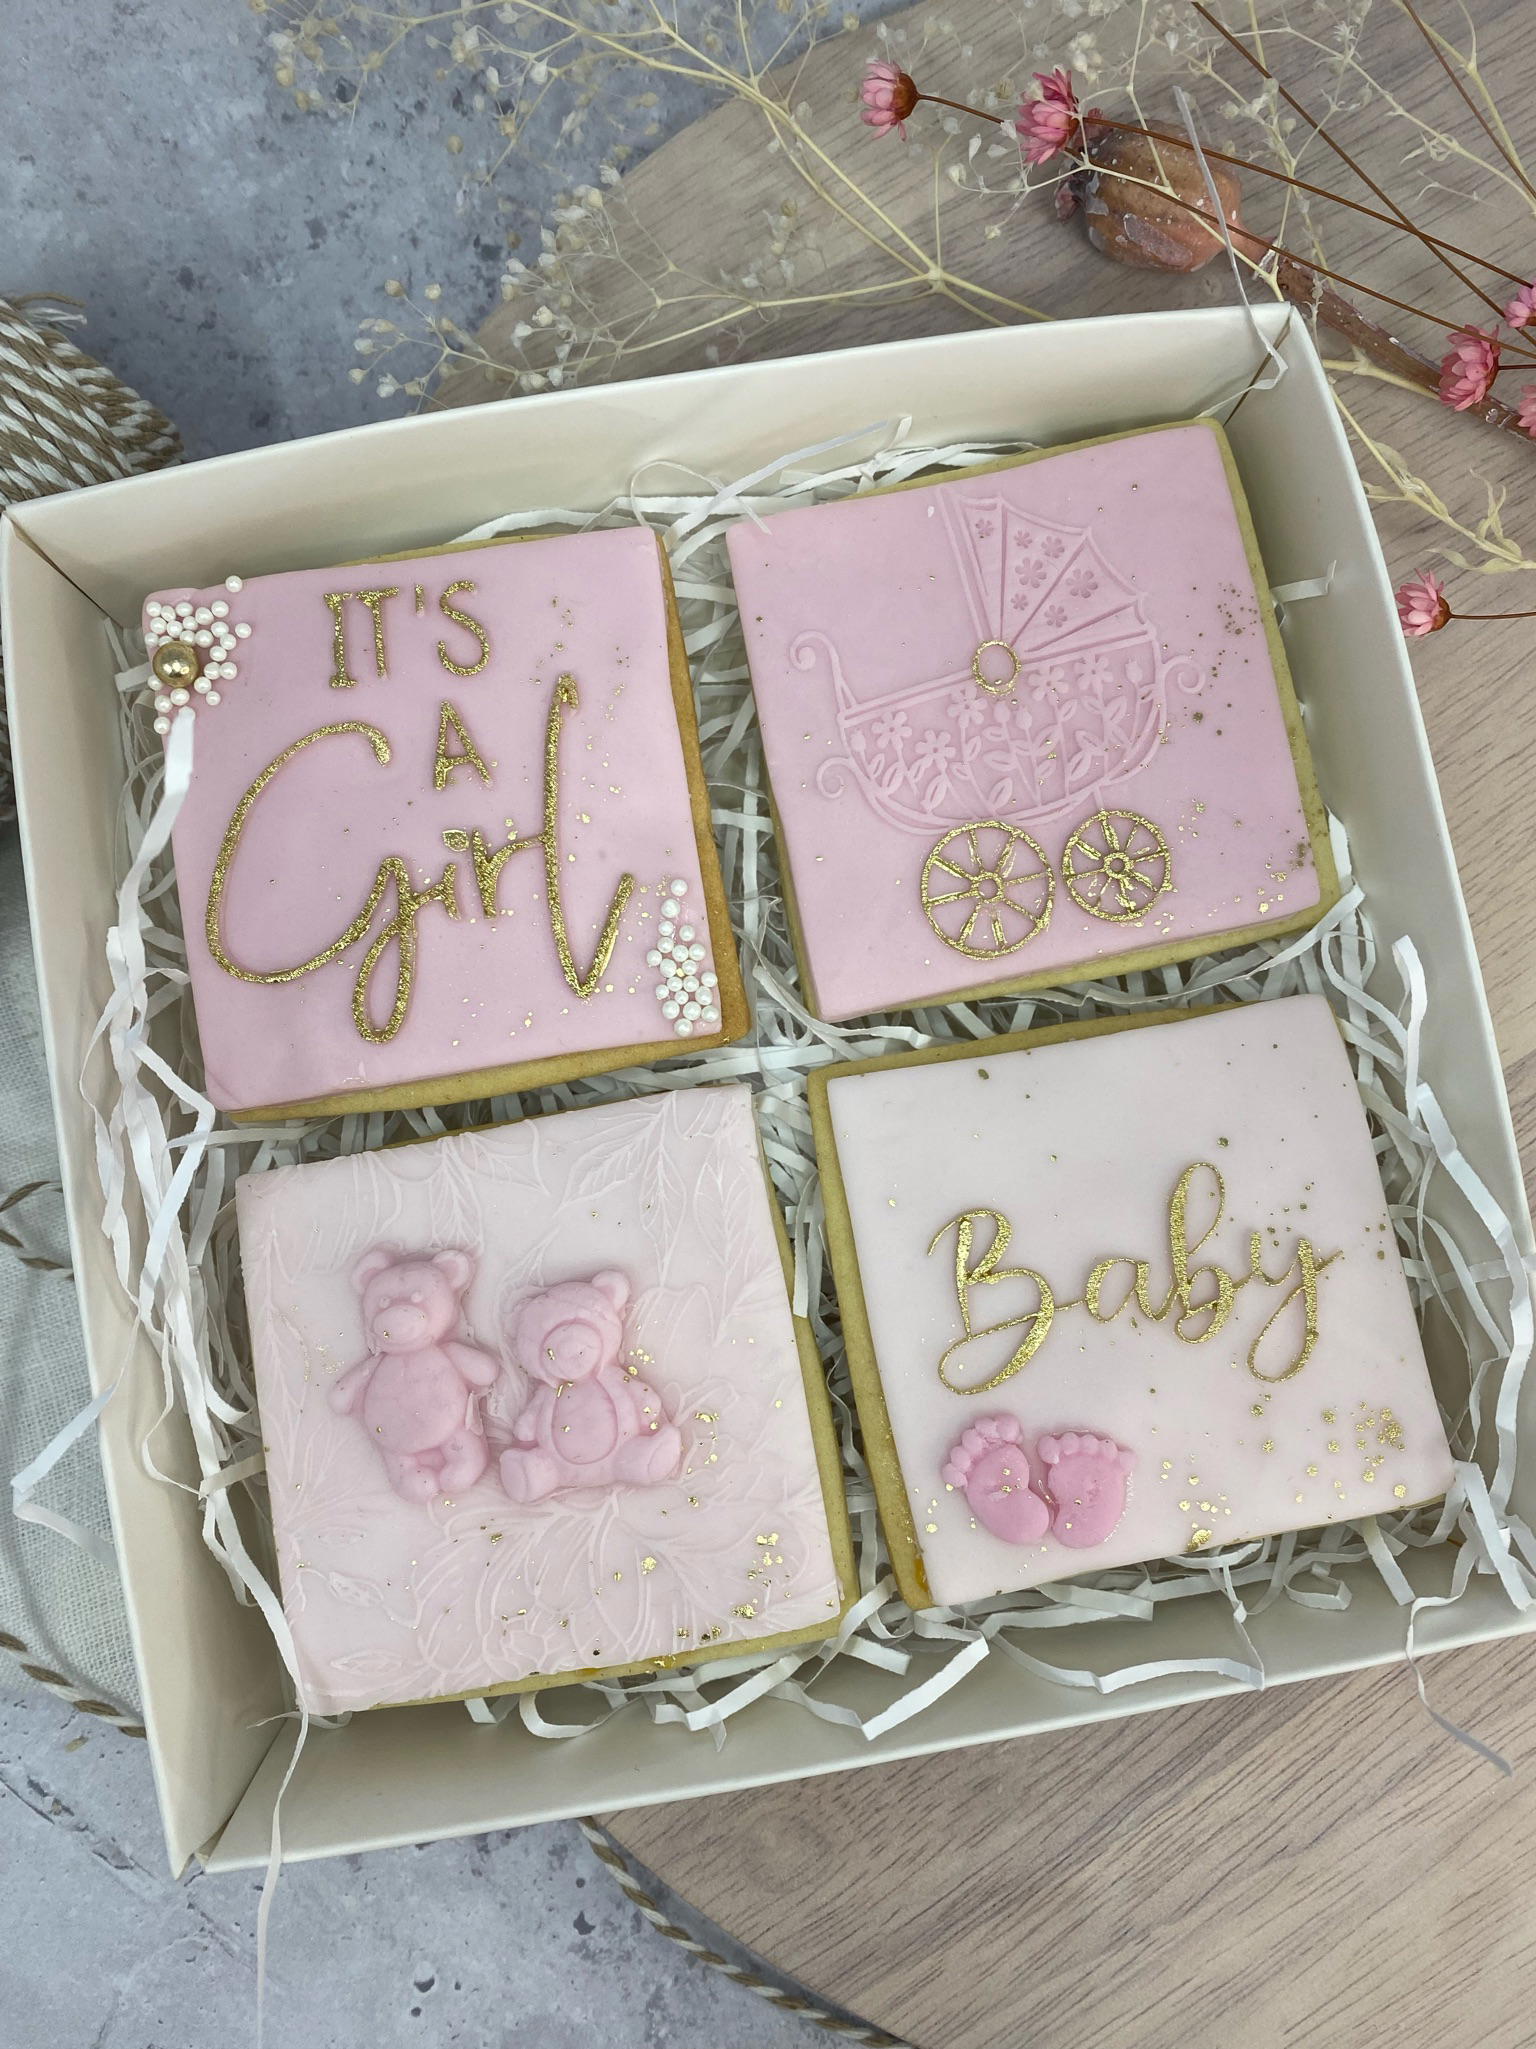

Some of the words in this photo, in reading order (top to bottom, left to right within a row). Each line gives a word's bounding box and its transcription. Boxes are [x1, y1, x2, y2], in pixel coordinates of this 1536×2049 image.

[323, 580, 490, 689] IT'S
[432, 700, 494, 791] A
[205, 673, 636, 1044] Girl
[926, 1161, 1343, 1396] Baby
